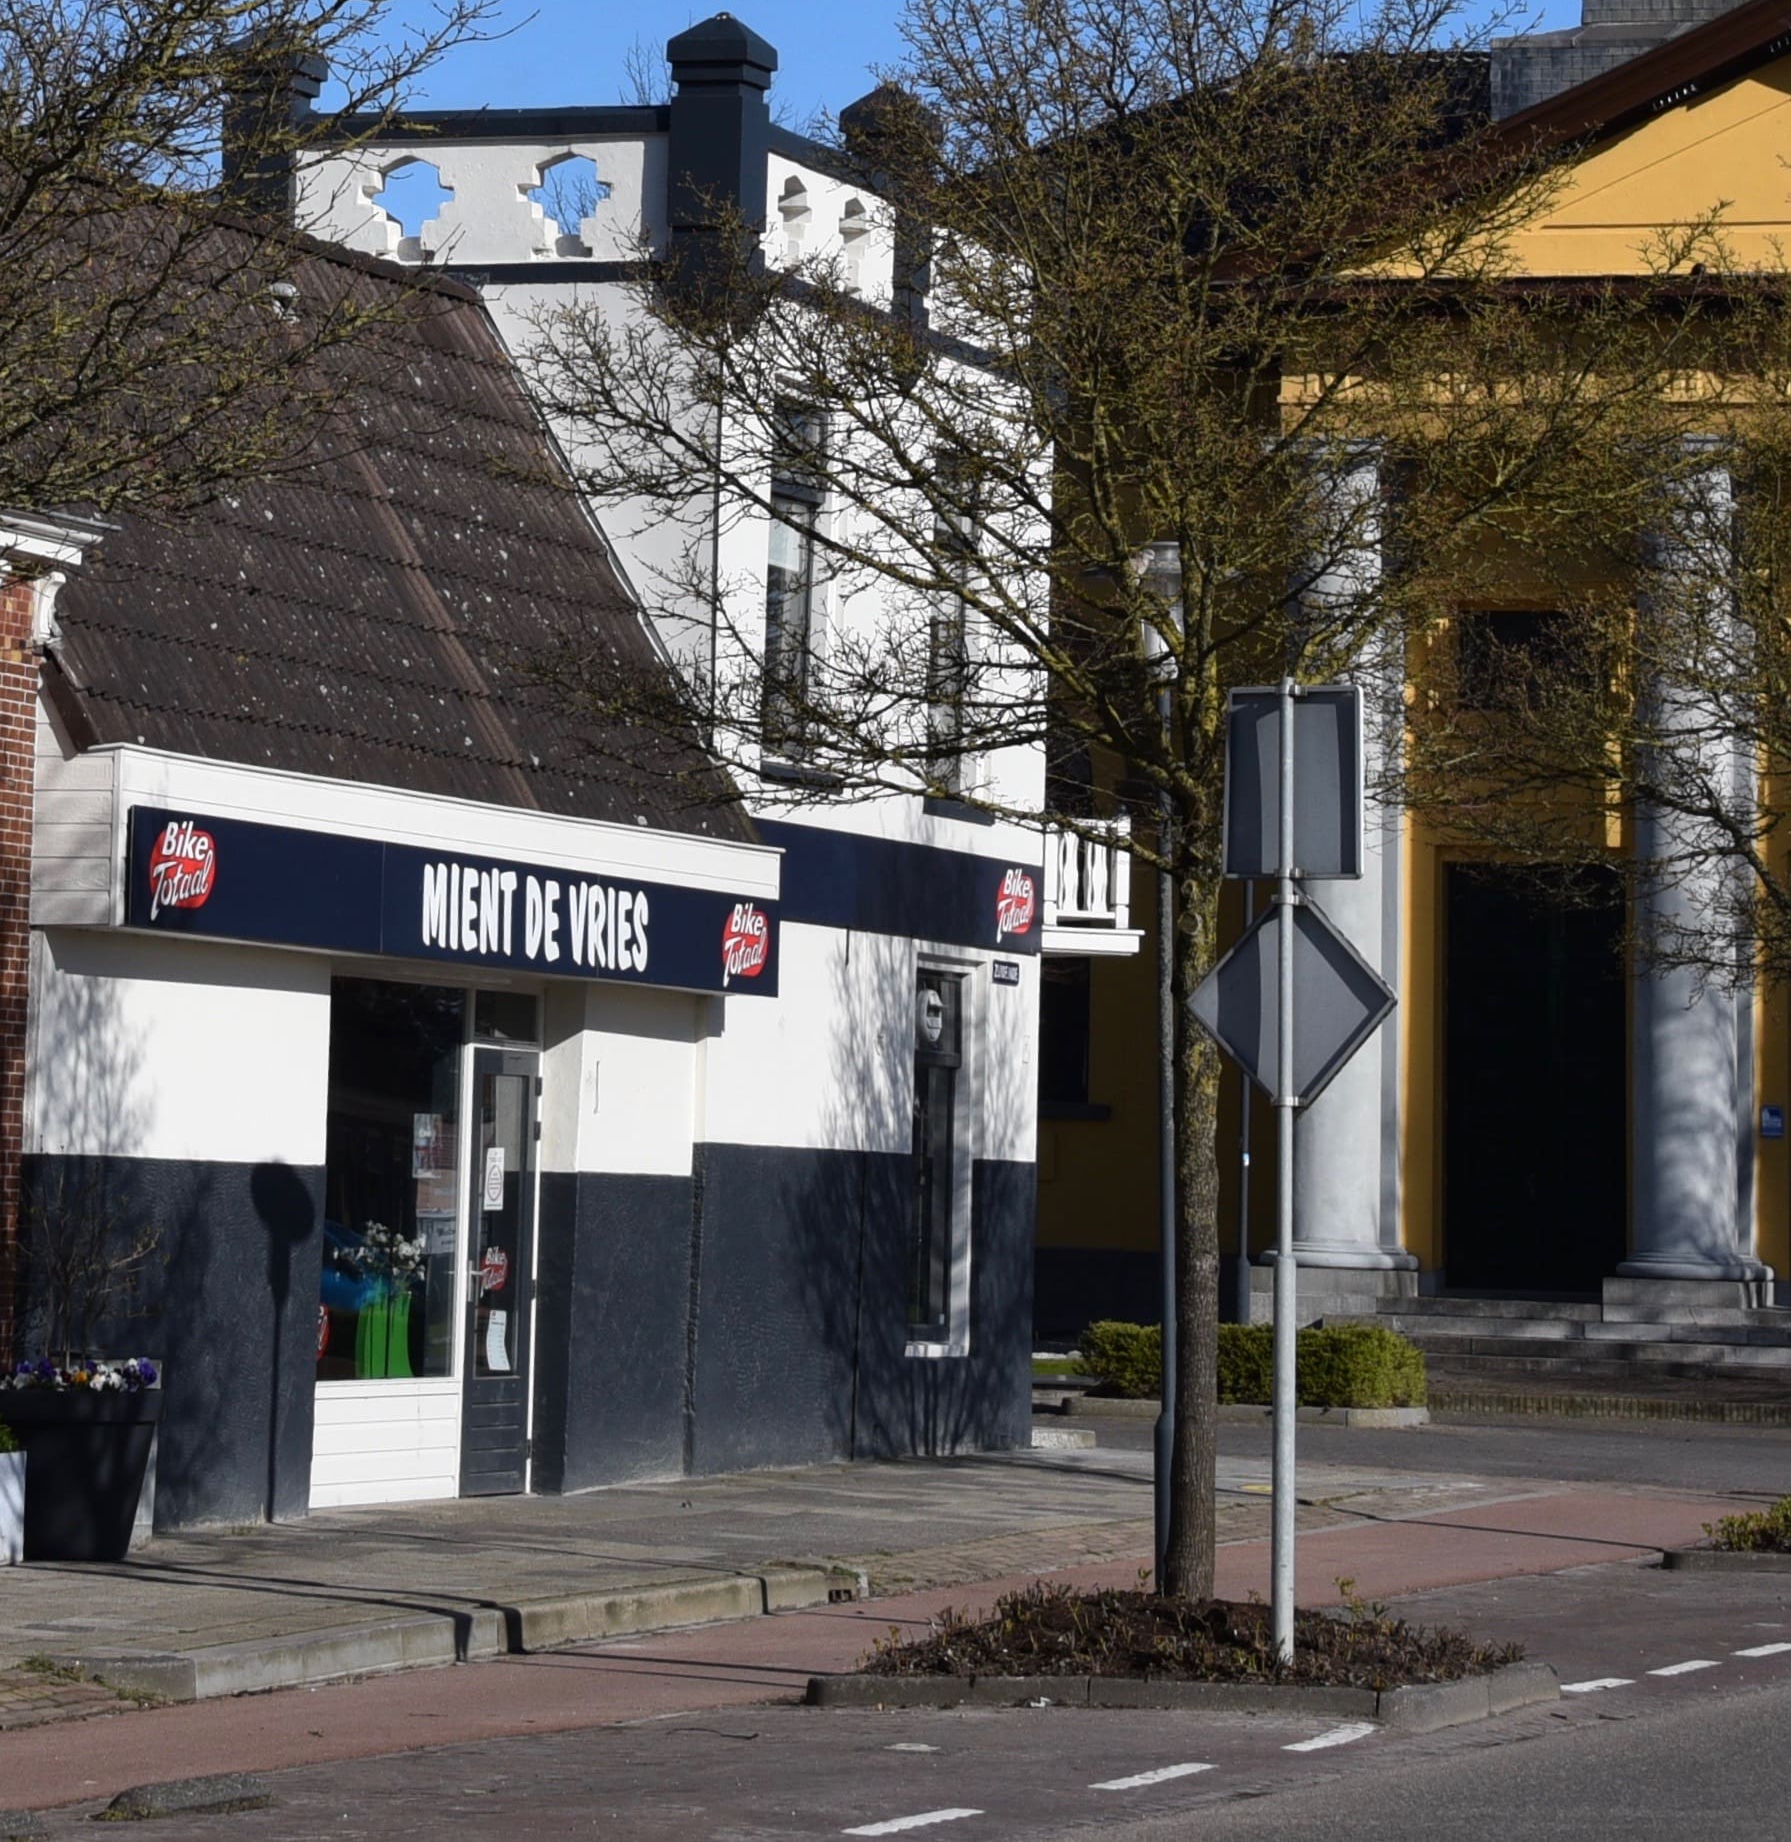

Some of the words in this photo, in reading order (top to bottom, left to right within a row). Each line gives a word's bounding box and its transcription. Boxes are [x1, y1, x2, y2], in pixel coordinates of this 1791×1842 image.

[161, 820, 209, 861] Bike
[150, 849, 214, 921] Totaal
[1002, 868, 1031, 898] Bike
[422, 862, 518, 957] MIENT
[525, 875, 561, 963] DE
[569, 881, 649, 973] VRIES
[730, 902, 764, 936] Bike
[996, 889, 1034, 944] Totaal
[723, 926, 768, 987] Totaal
